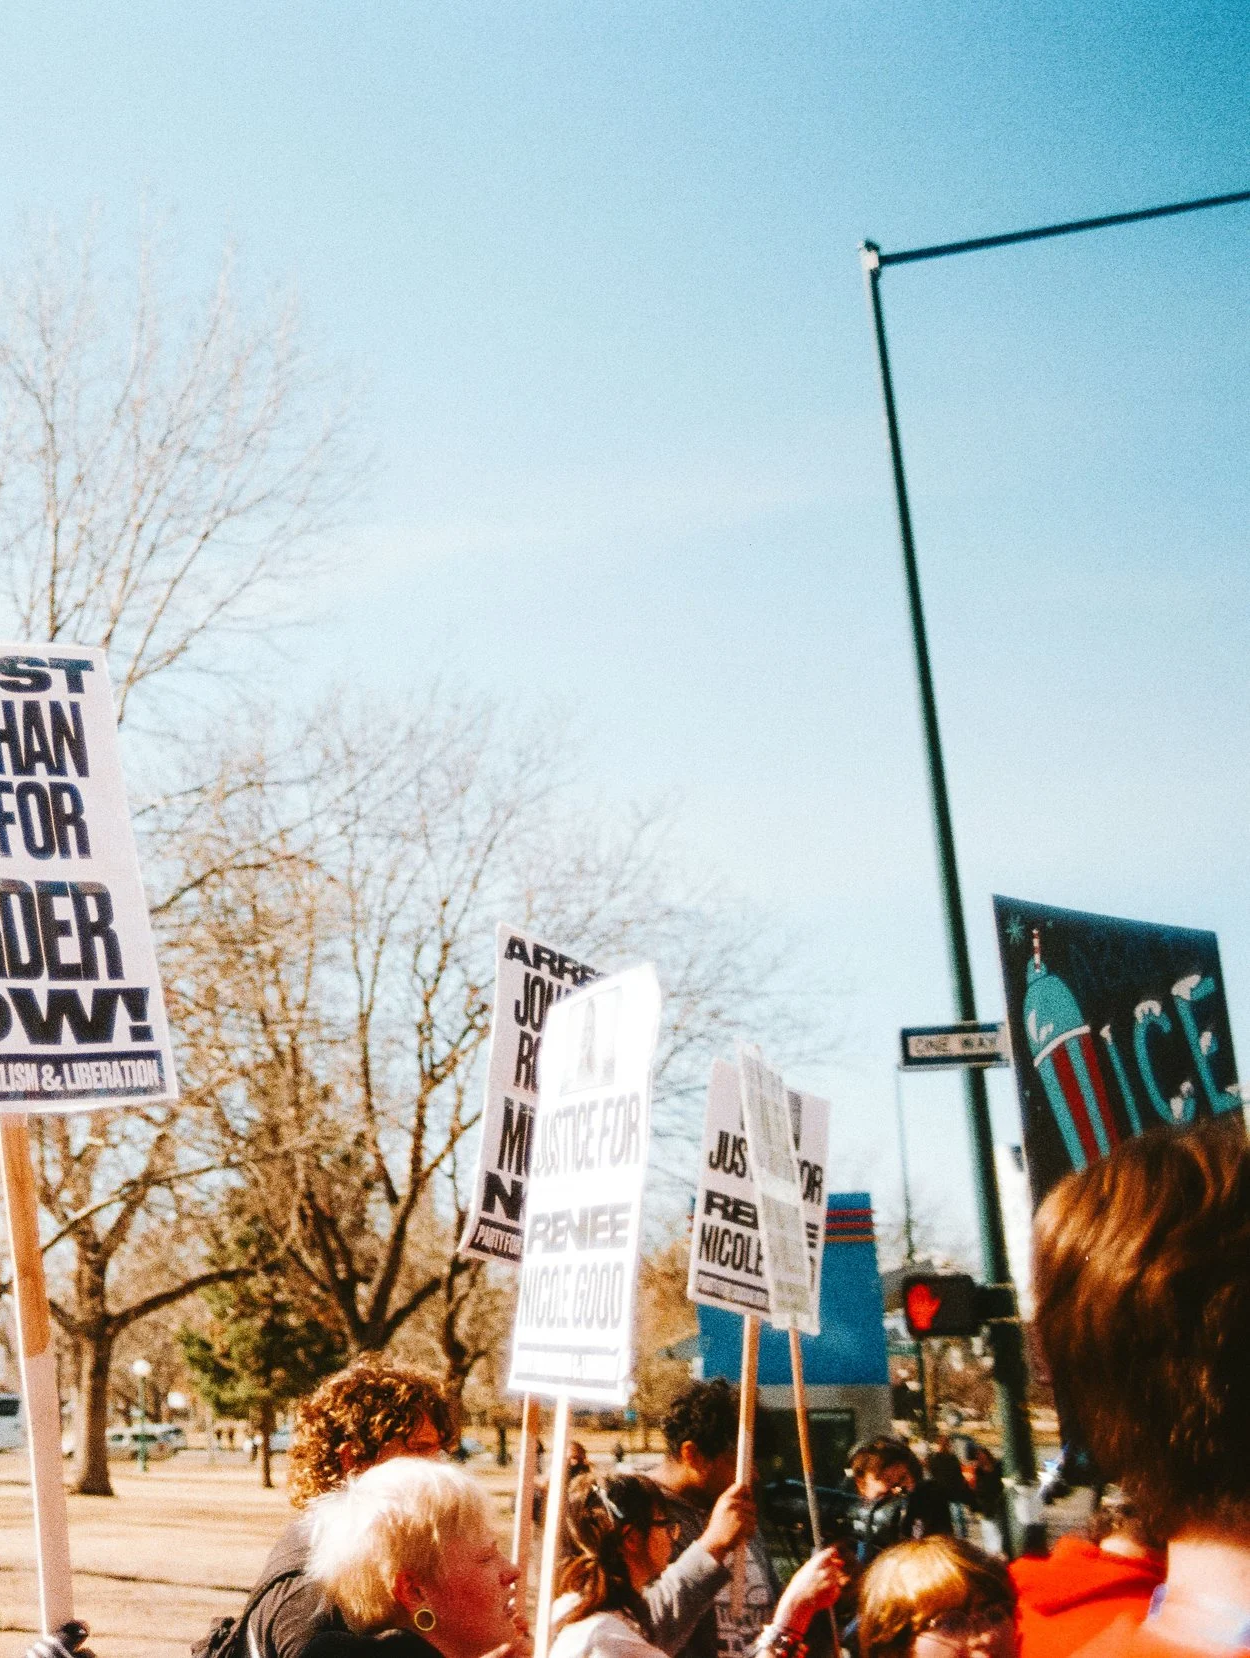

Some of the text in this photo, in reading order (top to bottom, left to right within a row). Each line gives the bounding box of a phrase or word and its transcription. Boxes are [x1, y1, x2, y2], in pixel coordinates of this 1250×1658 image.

[41, 1064, 63, 1092] &
[62, 1059, 159, 1091] LIBERATION
[1100, 973, 1242, 1136] ICE
[533, 1100, 598, 1178] JUSTICE
[598, 1091, 641, 1169] FOR
[526, 1202, 632, 1256] RENEE
[518, 1264, 571, 1330] NICOLE
[572, 1261, 625, 1330] GOOD
